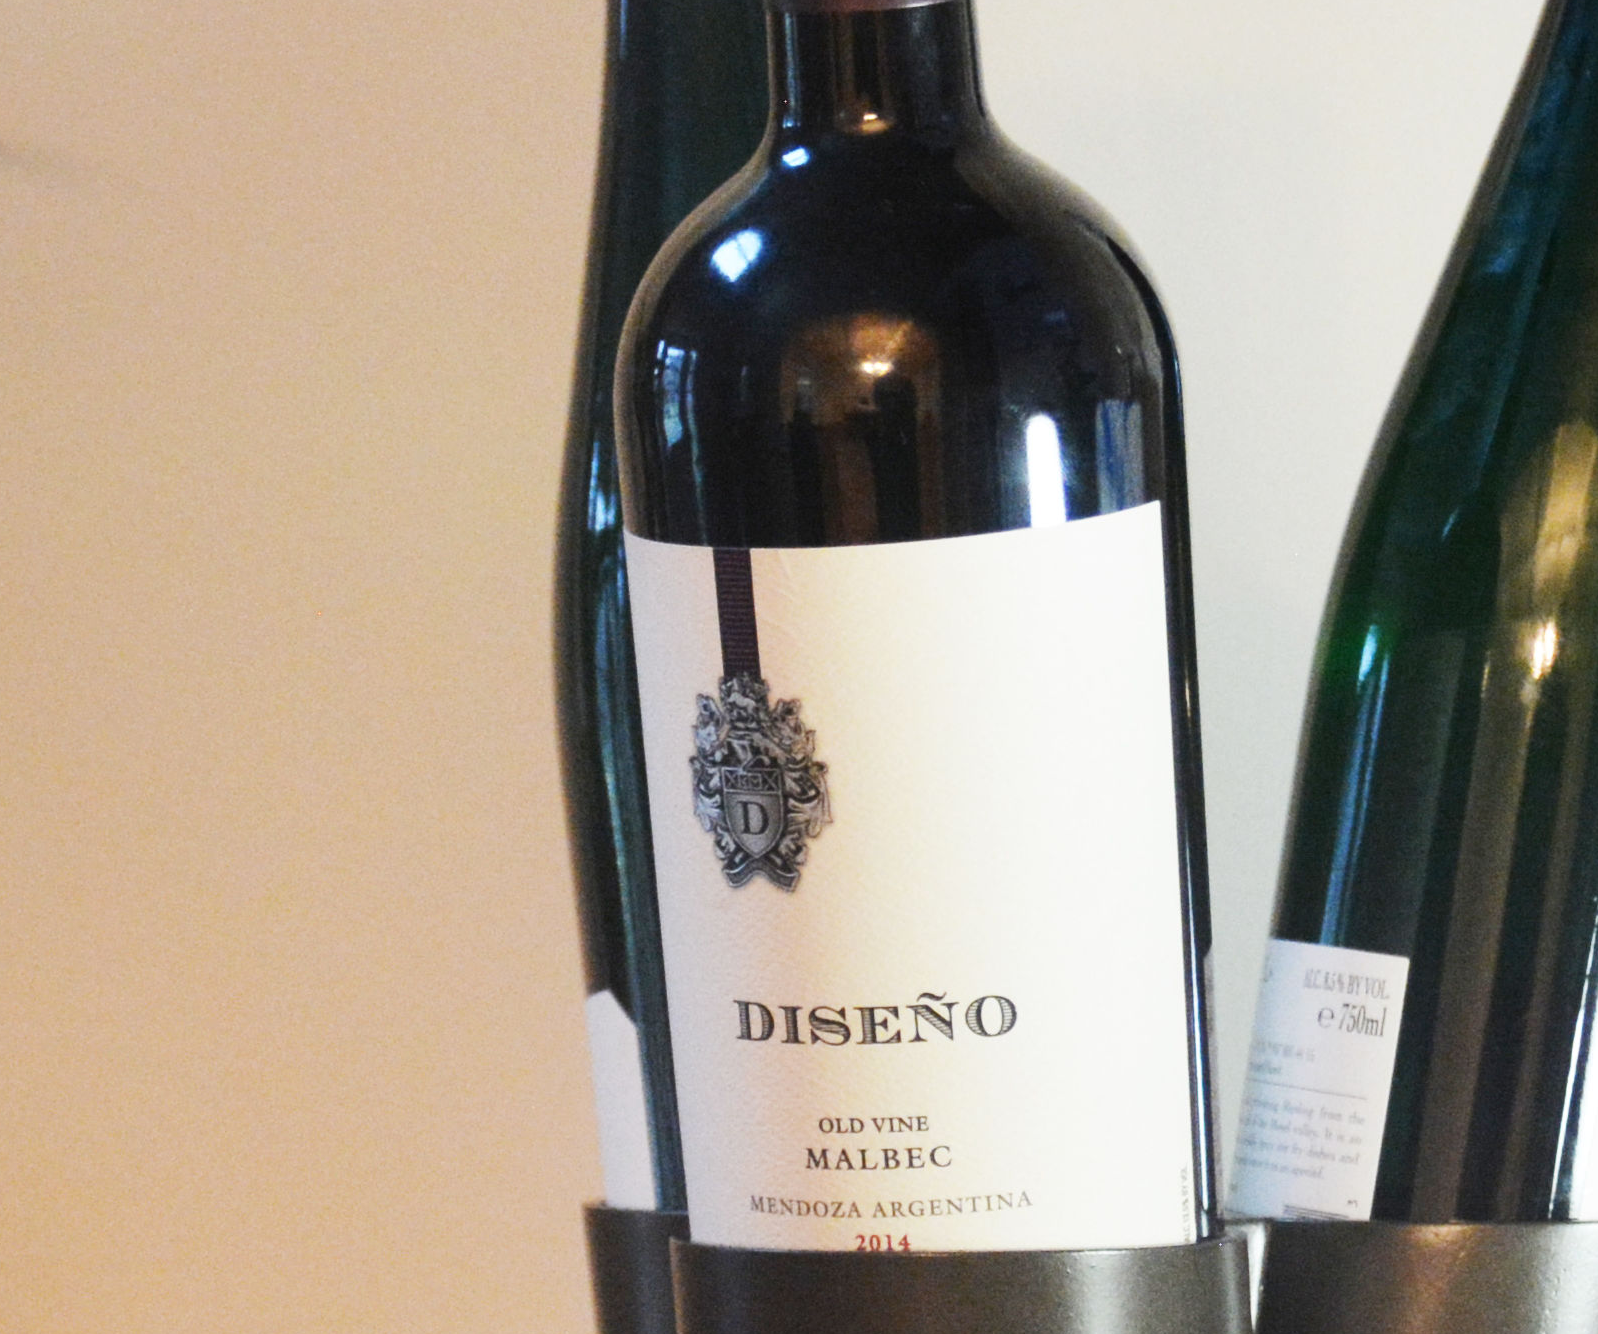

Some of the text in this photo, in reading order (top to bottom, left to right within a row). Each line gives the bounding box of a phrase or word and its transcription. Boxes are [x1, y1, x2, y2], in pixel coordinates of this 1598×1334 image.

[736, 800, 770, 836] D
[1347, 974, 1364, 996] BY
[733, 991, 1018, 1047] DISEÑO
[1338, 1002, 1387, 1038] 750ml
[817, 1115, 930, 1134] OLD VINE
[805, 1145, 953, 1171] MALBEC
[750, 1190, 1034, 1219] MENDOZA ARGENTINA
[854, 1233, 912, 1252] 2014
